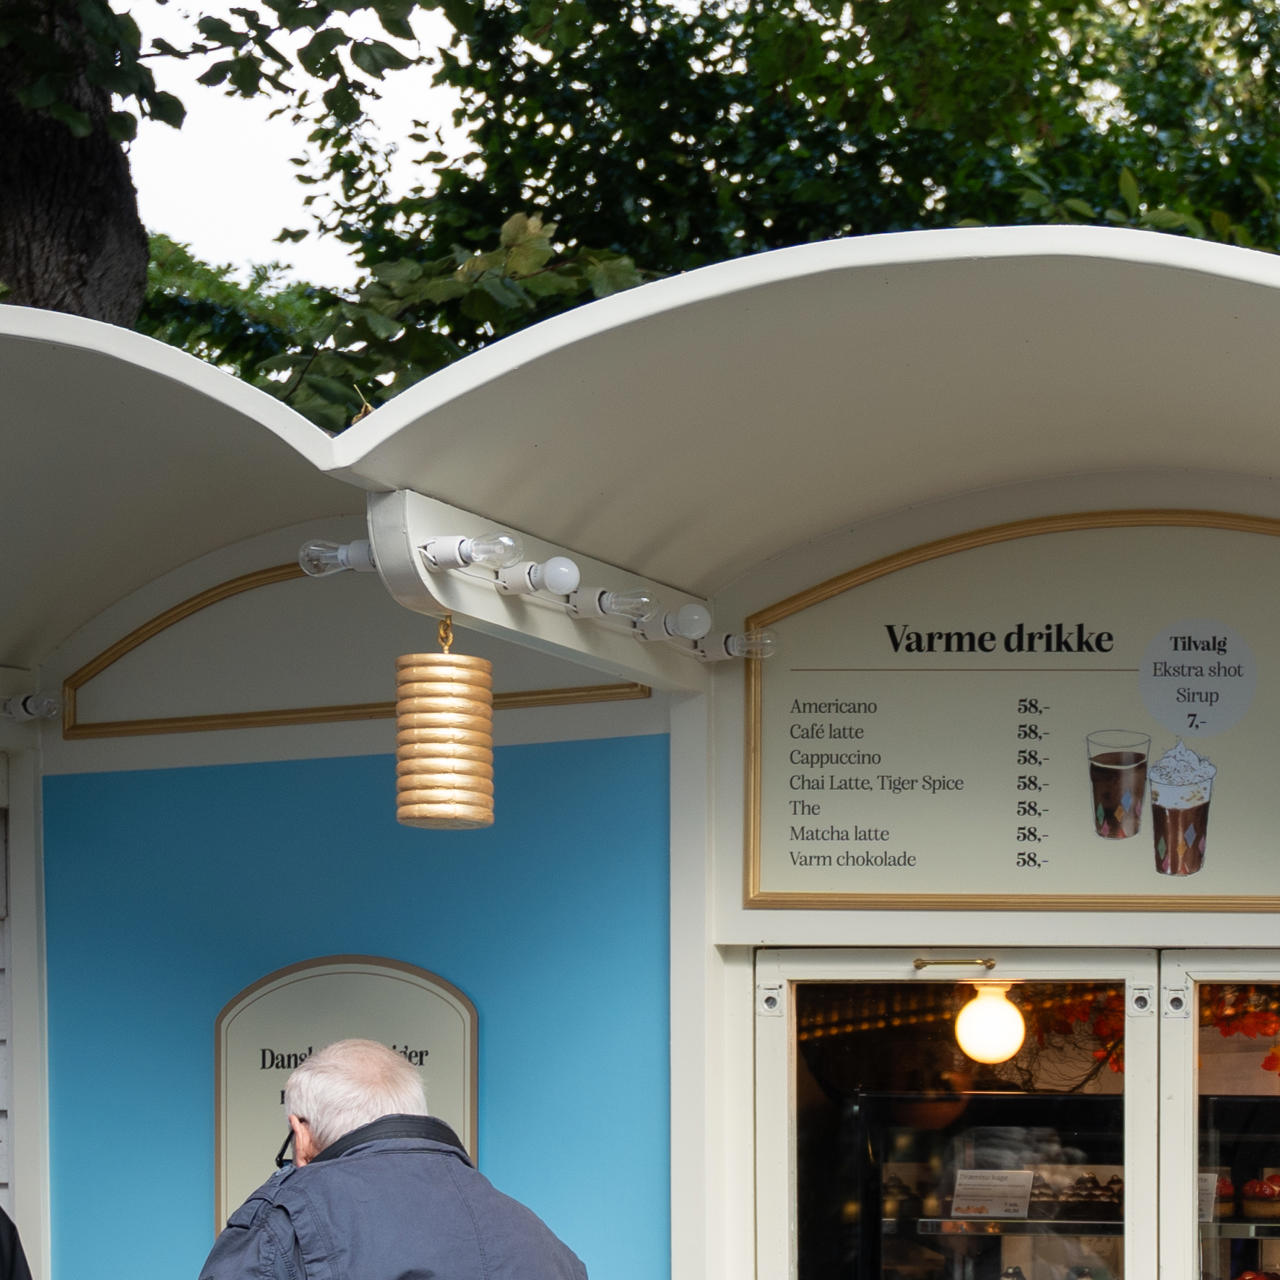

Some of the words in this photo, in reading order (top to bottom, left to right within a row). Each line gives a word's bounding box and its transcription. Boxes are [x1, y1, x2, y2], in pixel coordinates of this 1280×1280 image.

[886, 624, 996, 653] Varme
[1004, 623, 1114, 653] drikke
[1170, 636, 1227, 654] Tilvalg
[1153, 662, 1204, 678] Ekstra
[1209, 661, 1243, 678] shot
[1176, 688, 1219, 706] Sirup
[791, 699, 877, 715] Americano
[1017, 699, 1050, 716] 58,-
[1187, 713, 1207, 730] 7,-
[791, 723, 825, 740] Café
[829, 723, 863, 740] latte
[1017, 724, 1050, 742] 58,-
[790, 750, 881, 768] Cappuccino
[1017, 750, 1050, 768] 58,-
[790, 775, 825, 791] Chai
[829, 775, 873, 792] Latte,
[877, 775, 918, 794] Tiger
[922, 775, 964, 794] Spice
[1017, 776, 1050, 793] 58,-
[790, 800, 820, 816] The
[1017, 801, 1050, 818] 58,-
[790, 826, 849, 842] Matcha
[854, 826, 889, 842] latte
[1017, 827, 1050, 844] 58,-
[790, 851, 832, 867] Varm
[837, 851, 916, 868] chokolade
[1017, 852, 1050, 868] 58,-
[260, 1046, 313, 1070] Dans
